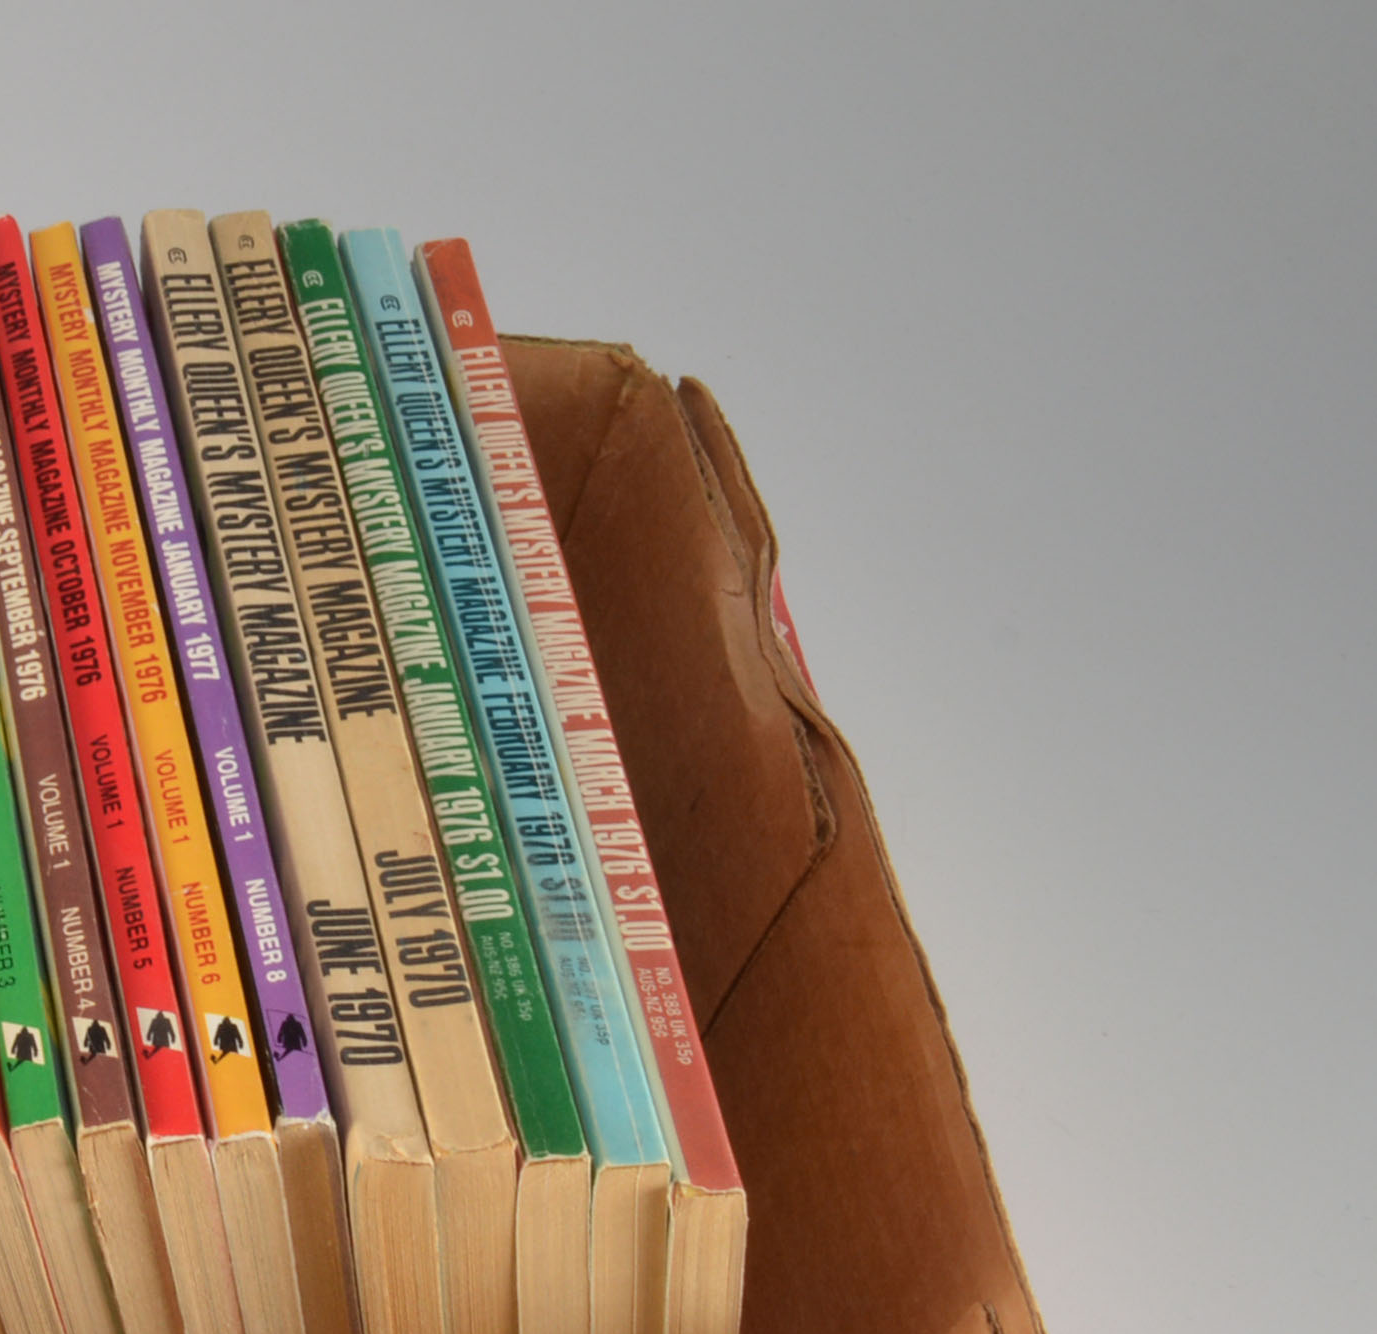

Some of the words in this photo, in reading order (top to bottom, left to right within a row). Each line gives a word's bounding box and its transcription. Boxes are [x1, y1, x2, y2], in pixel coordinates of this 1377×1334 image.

[96, 261, 139, 343] MYSTERY
[161, 273, 230, 352] ELLERY
[117, 349, 162, 433] MONTHLY
[182, 361, 257, 462] QUEEN'S
[453, 346, 517, 414] ELLERY
[138, 438, 184, 534] MAGAZINE
[207, 470, 290, 593] MYSTERY
[499, 507, 577, 604] MYSTERY
[161, 541, 207, 626] JANUARY
[185, 633, 221, 681] 1977
[237, 602, 328, 745] MAGAZINE
[529, 611, 608, 724] MAGAZINE
[566, 730, 633, 812] MARCH
[214, 746, 251, 826] VOLUME
[233, 830, 252, 843] 1
[245, 878, 284, 966] NUMBER
[266, 970, 287, 983] 8
[591, 819, 651, 875] 1976
[306, 899, 383, 977] JUNE
[611, 885, 672, 952] $1.00
[327, 987, 404, 1066] 1970
[670, 1019, 688, 1038] UK
